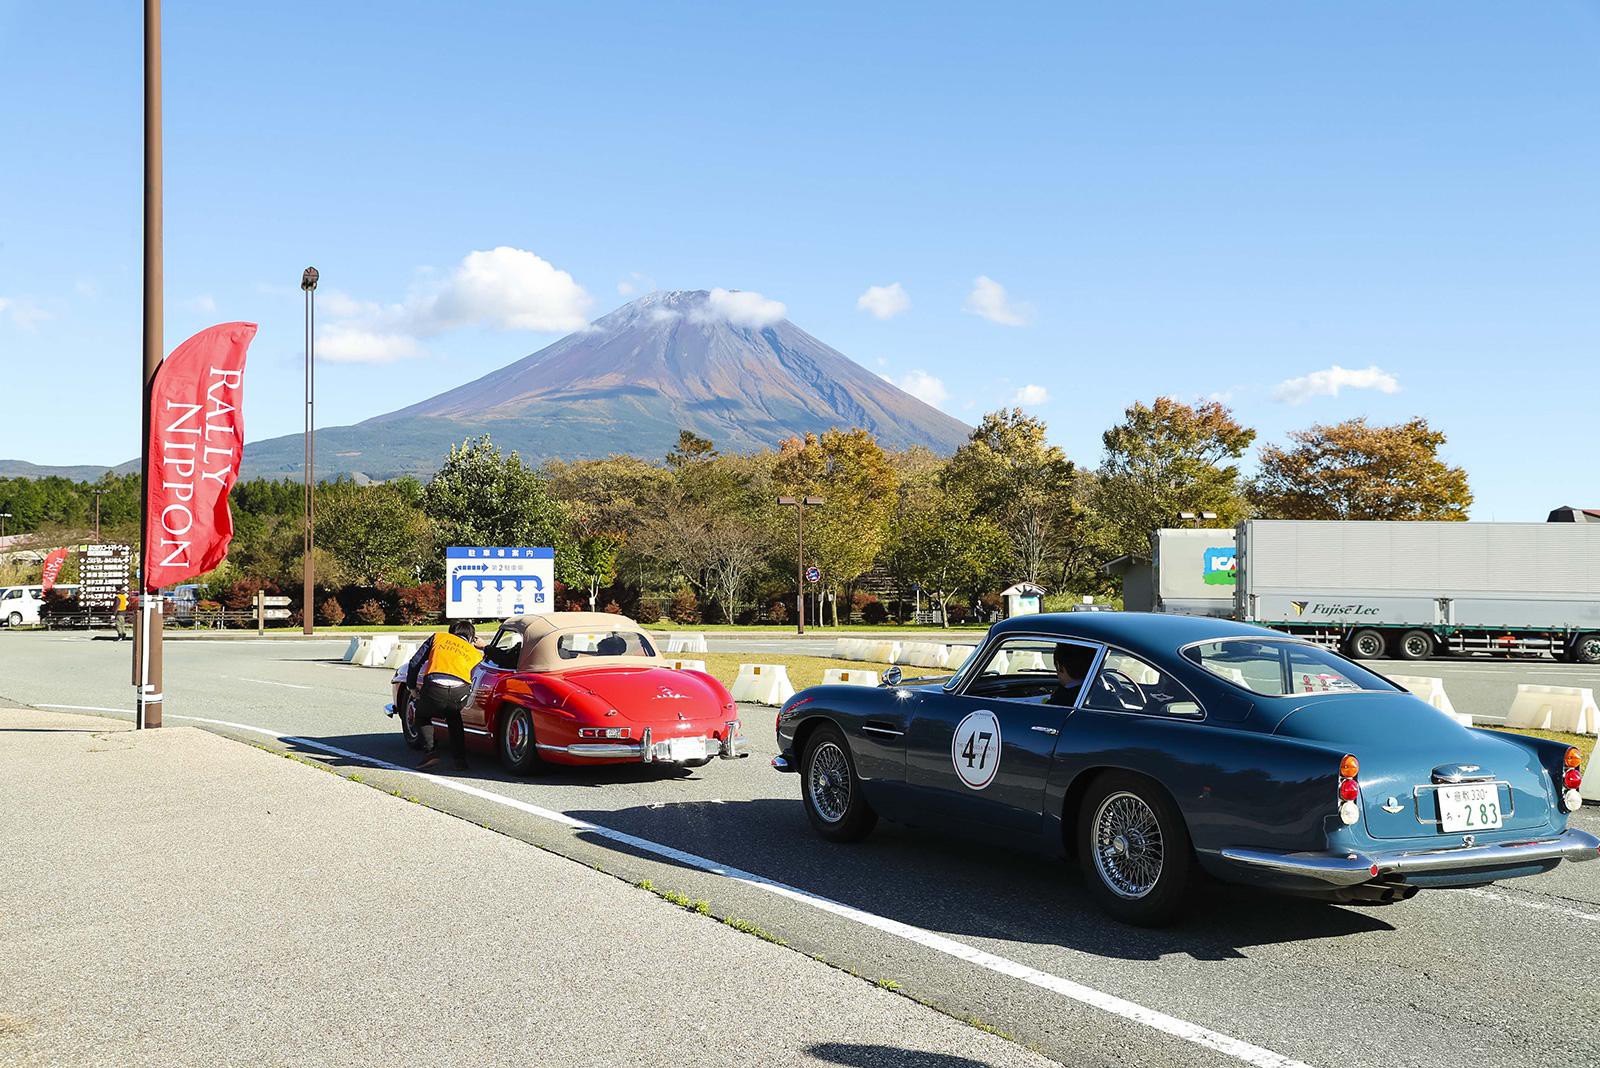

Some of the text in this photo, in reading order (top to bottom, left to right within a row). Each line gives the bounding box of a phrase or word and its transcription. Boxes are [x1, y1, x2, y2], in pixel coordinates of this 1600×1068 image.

[201, 365, 243, 488] RALLY
[159, 399, 204, 569] NIPPON
[1354, 604, 1380, 615] Lec
[962, 730, 993, 770] 47
